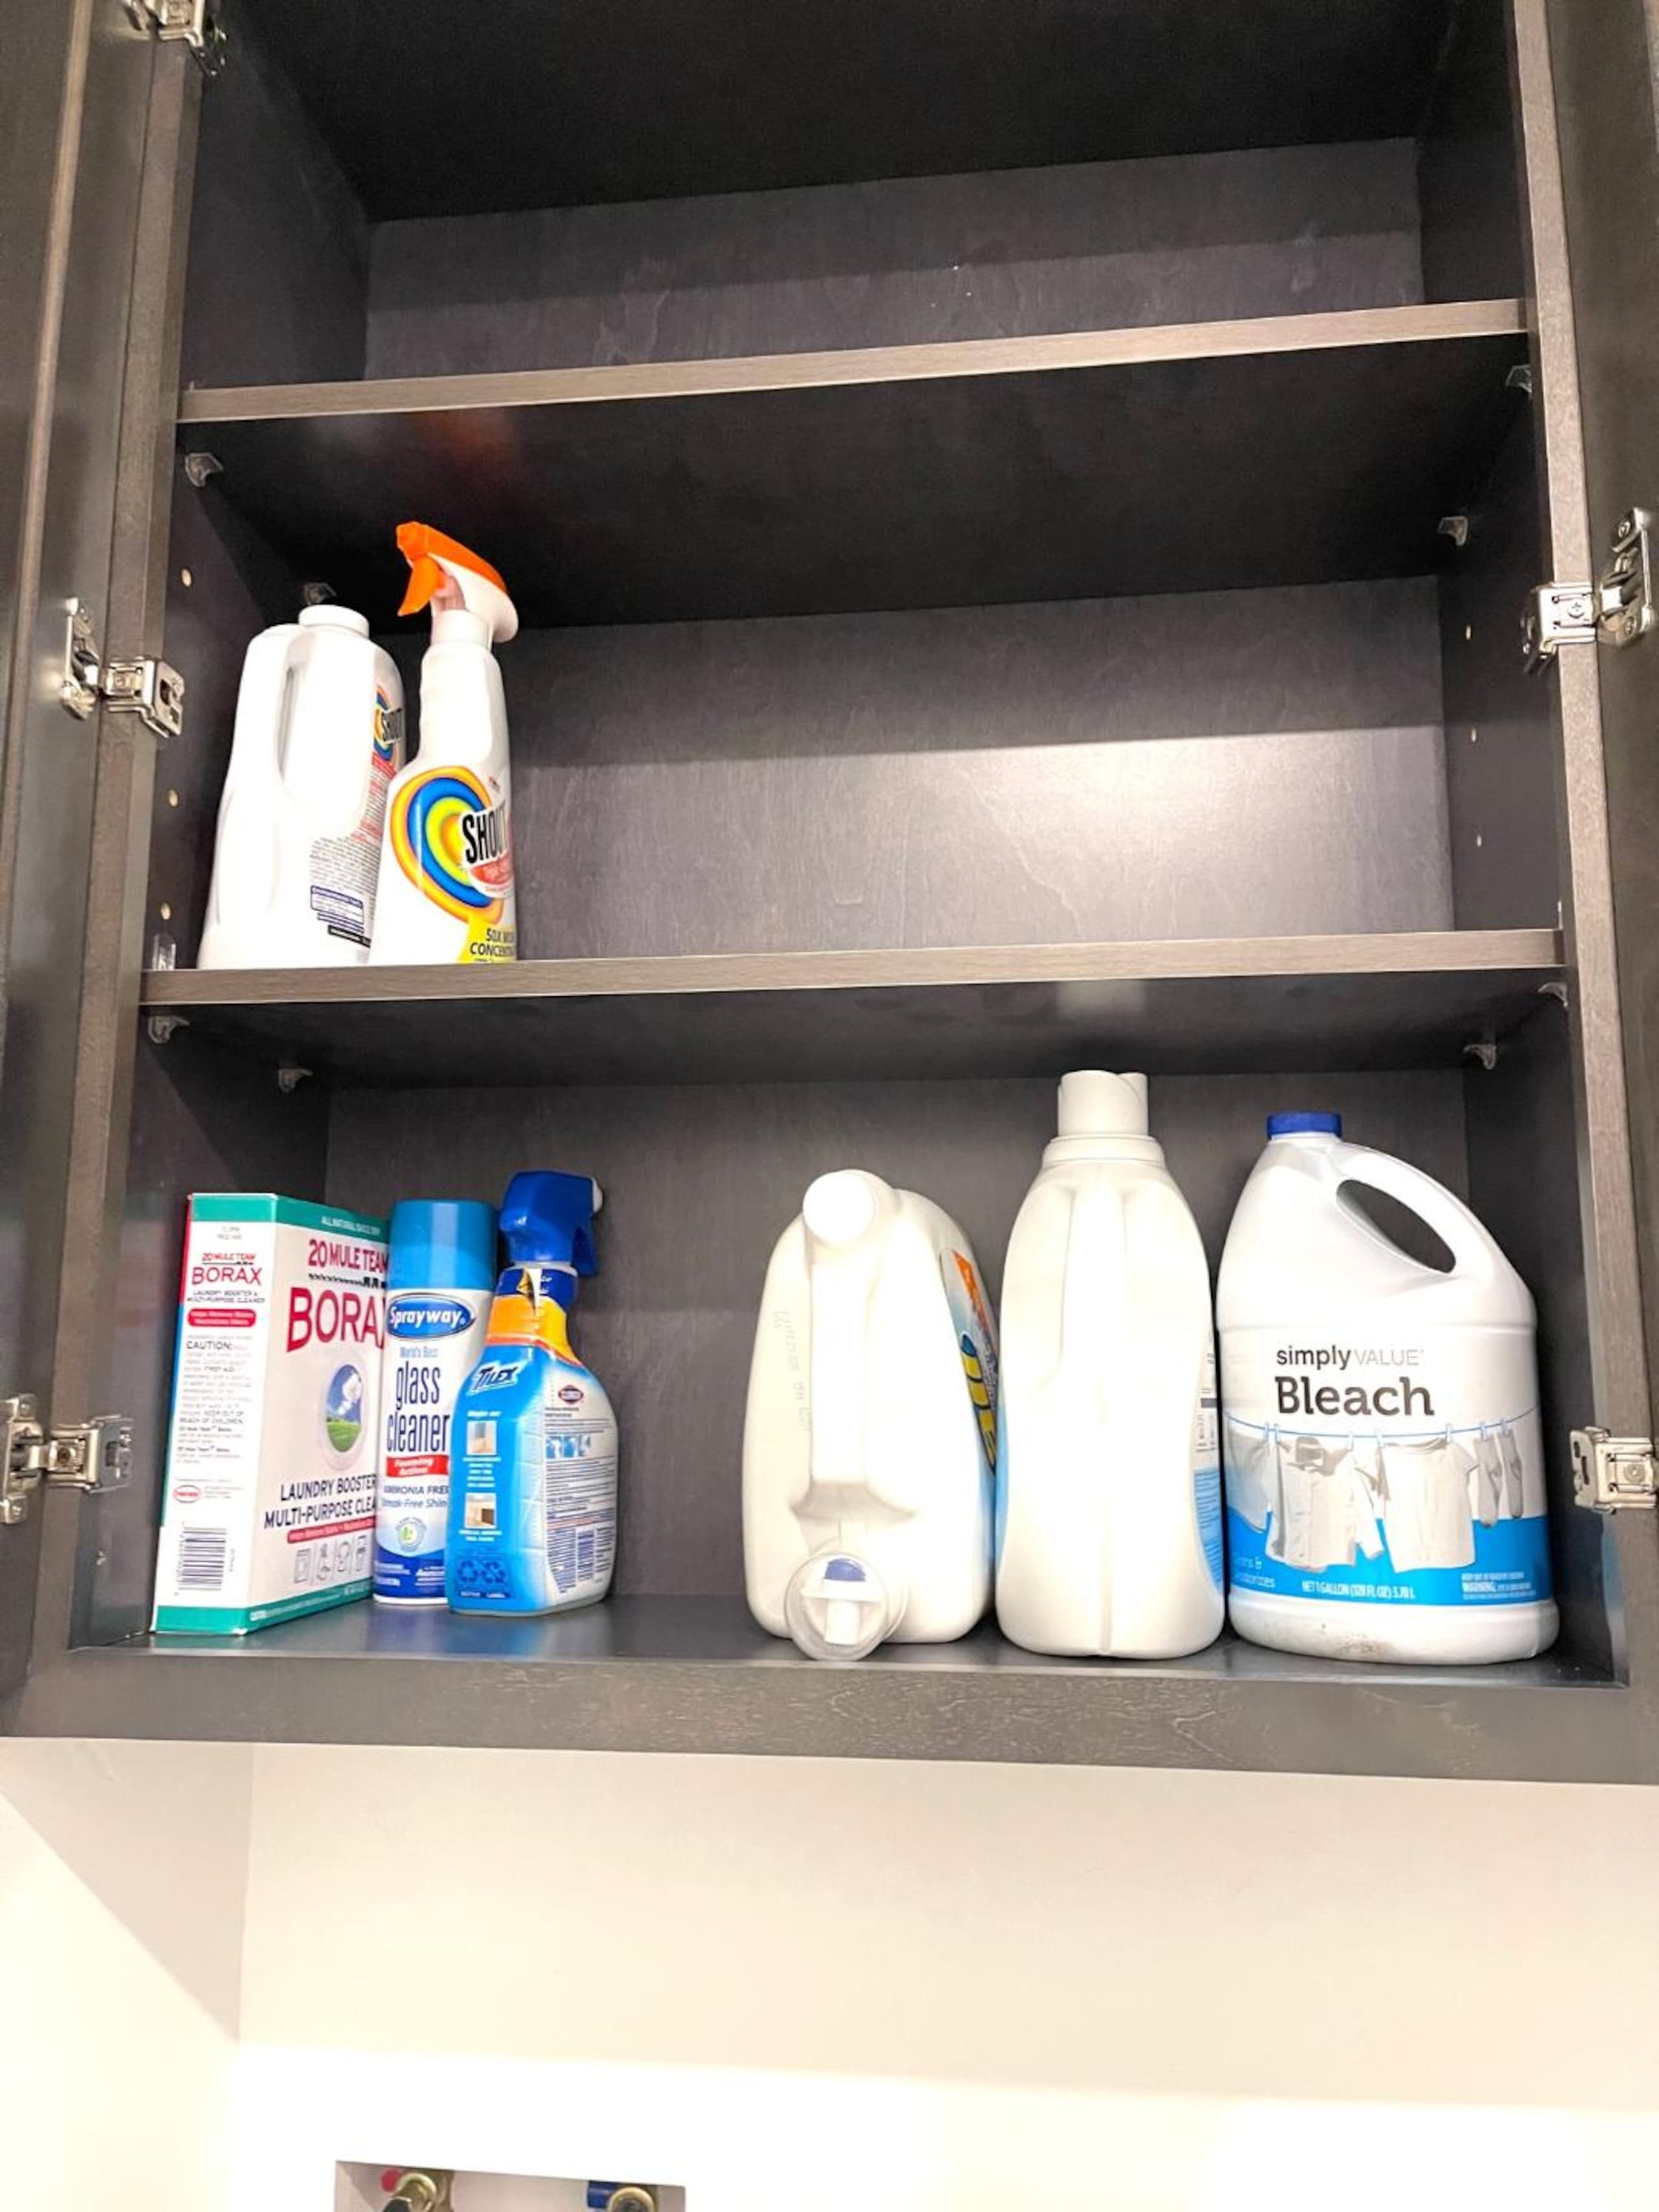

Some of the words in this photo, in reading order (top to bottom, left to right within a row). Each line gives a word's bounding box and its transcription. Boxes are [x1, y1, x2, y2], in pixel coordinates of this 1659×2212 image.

[308, 1239, 327, 1268] 20
[329, 1242, 360, 1269] MULE
[192, 1266, 262, 1286] BORAX
[286, 1286, 386, 1353] BORA
[389, 1305, 461, 1329] Sprayway
[1277, 1344, 1351, 1371] simply
[1353, 1349, 1420, 1366] VALUE
[395, 1360, 441, 1410] glass
[1275, 1375, 1435, 1416] Bleach
[386, 1412, 450, 1452] cleaner
[281, 1478, 335, 1501] LAUNDRY
[337, 1474, 377, 1493] BOOSTER
[264, 1500, 353, 1528] MULTI-PURPOSE
[356, 1496, 377, 1514] CLEA
